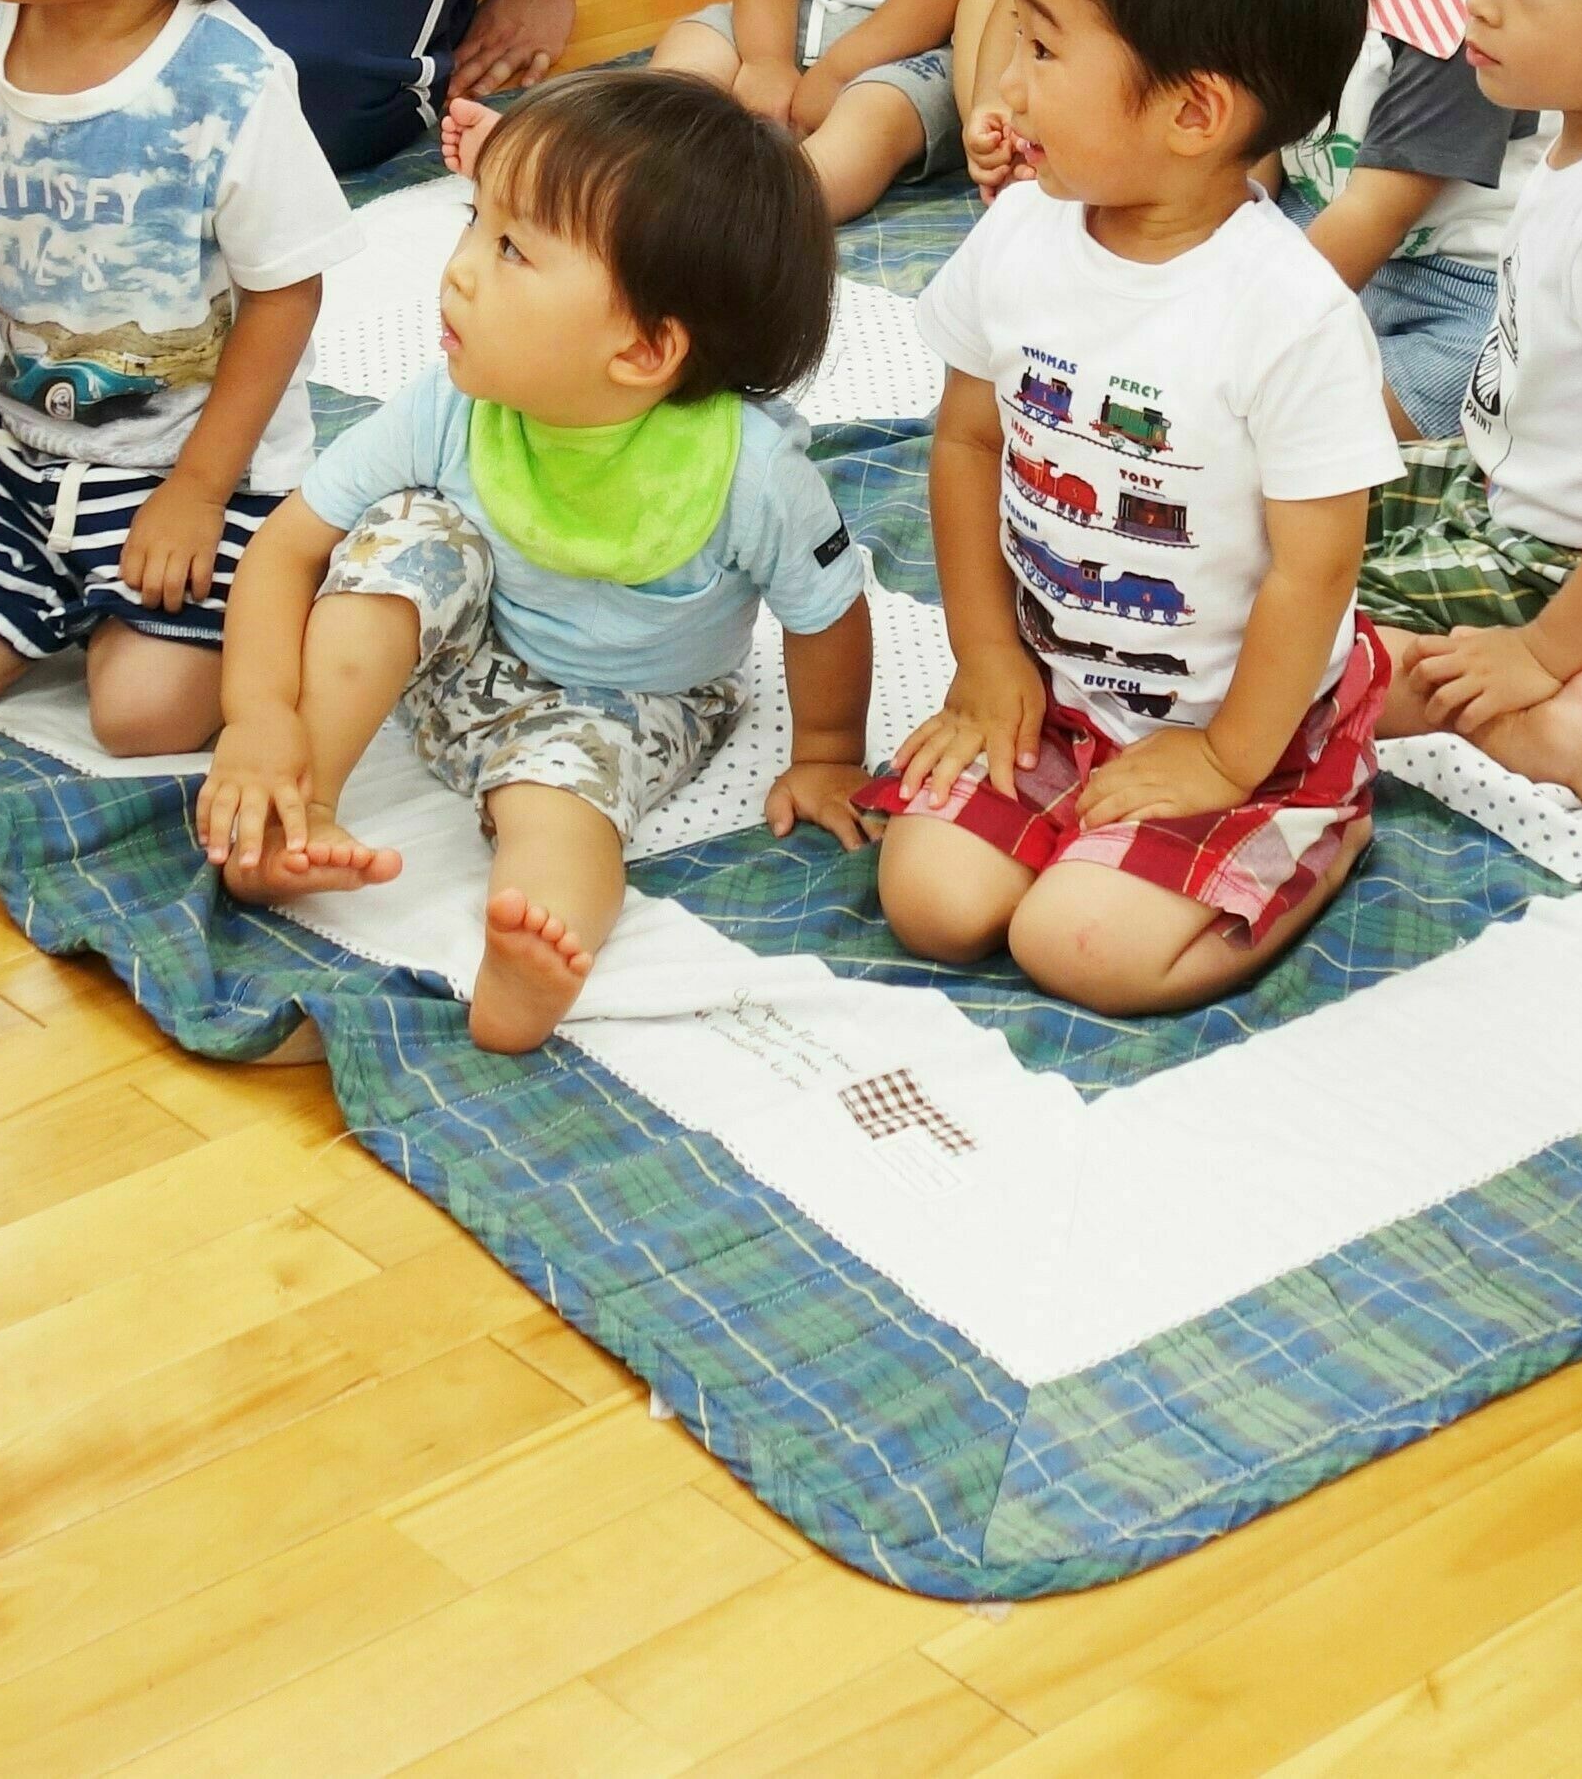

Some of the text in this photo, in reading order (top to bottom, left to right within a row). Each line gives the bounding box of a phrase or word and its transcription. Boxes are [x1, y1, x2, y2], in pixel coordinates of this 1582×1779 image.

[1022, 346, 1078, 375] THOMAS
[1109, 376, 1163, 400] PERCY
[1119, 469, 1164, 490] TOBY
[1083, 673, 1140, 694] BUTCH
